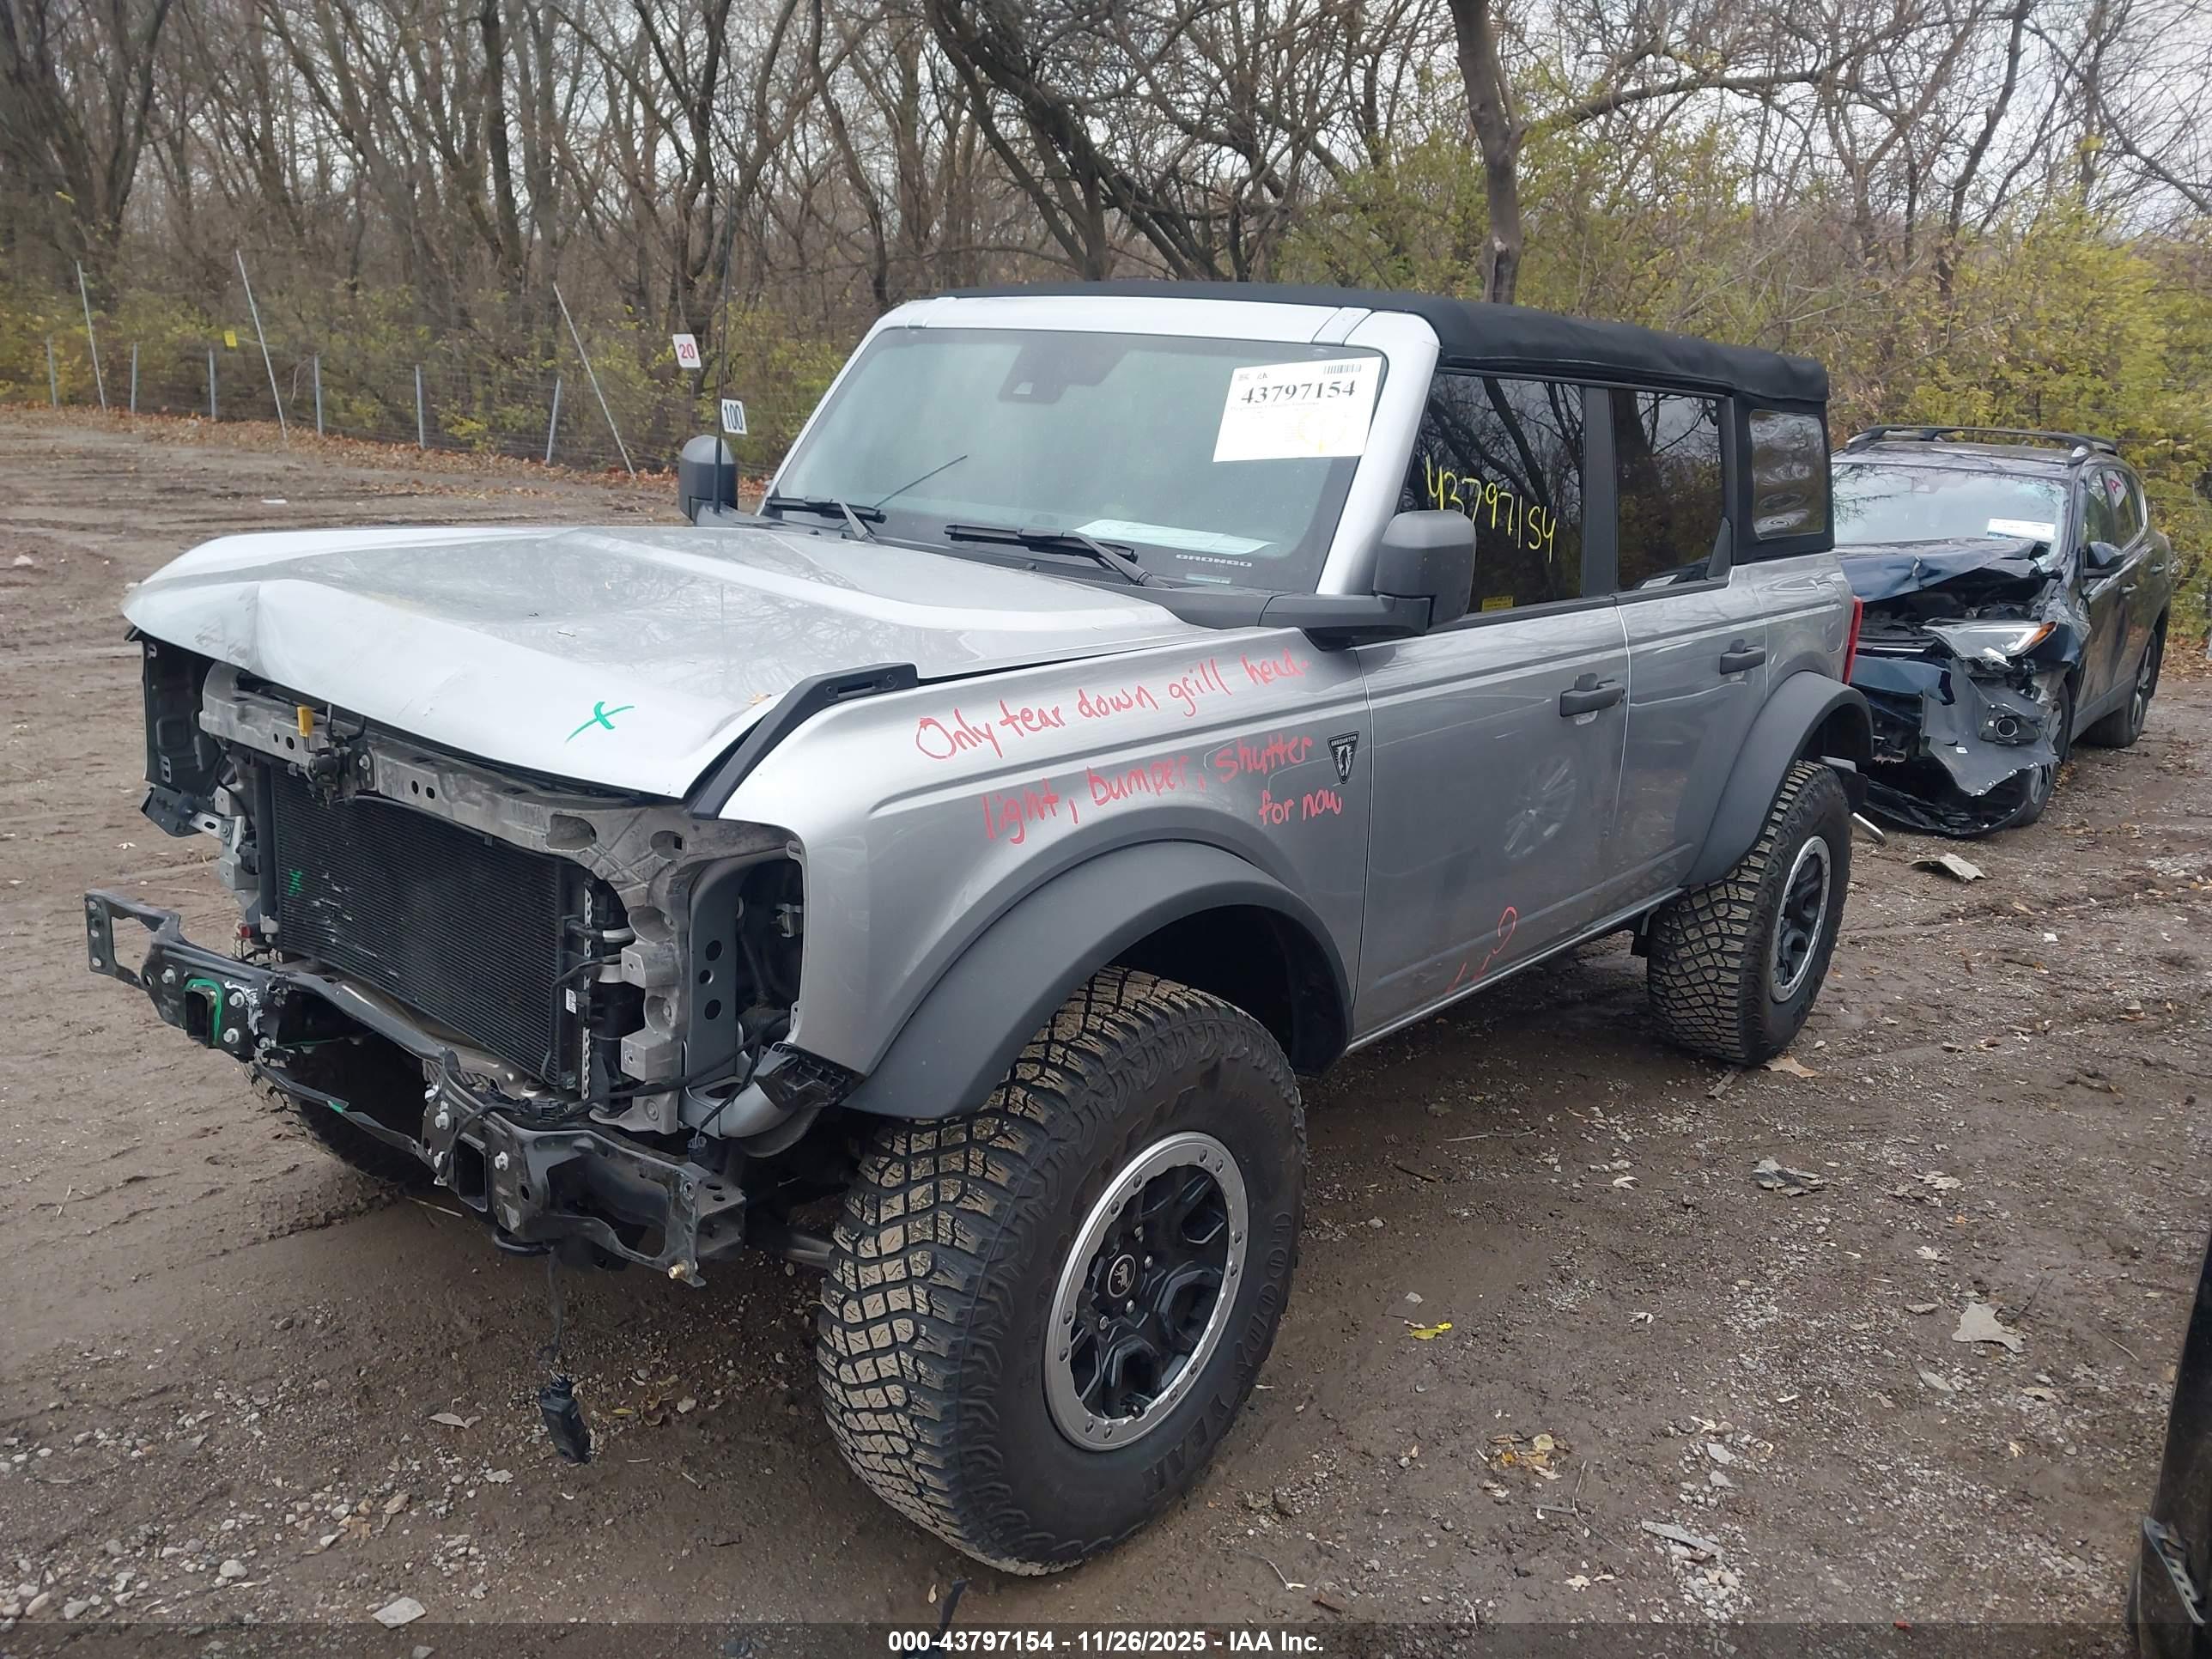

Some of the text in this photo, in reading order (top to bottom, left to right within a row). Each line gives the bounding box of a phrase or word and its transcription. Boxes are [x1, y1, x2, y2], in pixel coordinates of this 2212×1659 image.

[678, 343, 695, 359] 20
[1241, 380, 1356, 404] 43797154
[724, 403, 744, 430] 100
[1425, 454, 1557, 564] 43797154
[916, 708, 1003, 759] Only
[999, 699, 1066, 738] tear
[1078, 688, 1158, 718] down
[1169, 658, 1232, 717] grill
[1259, 789, 1342, 825] for now
